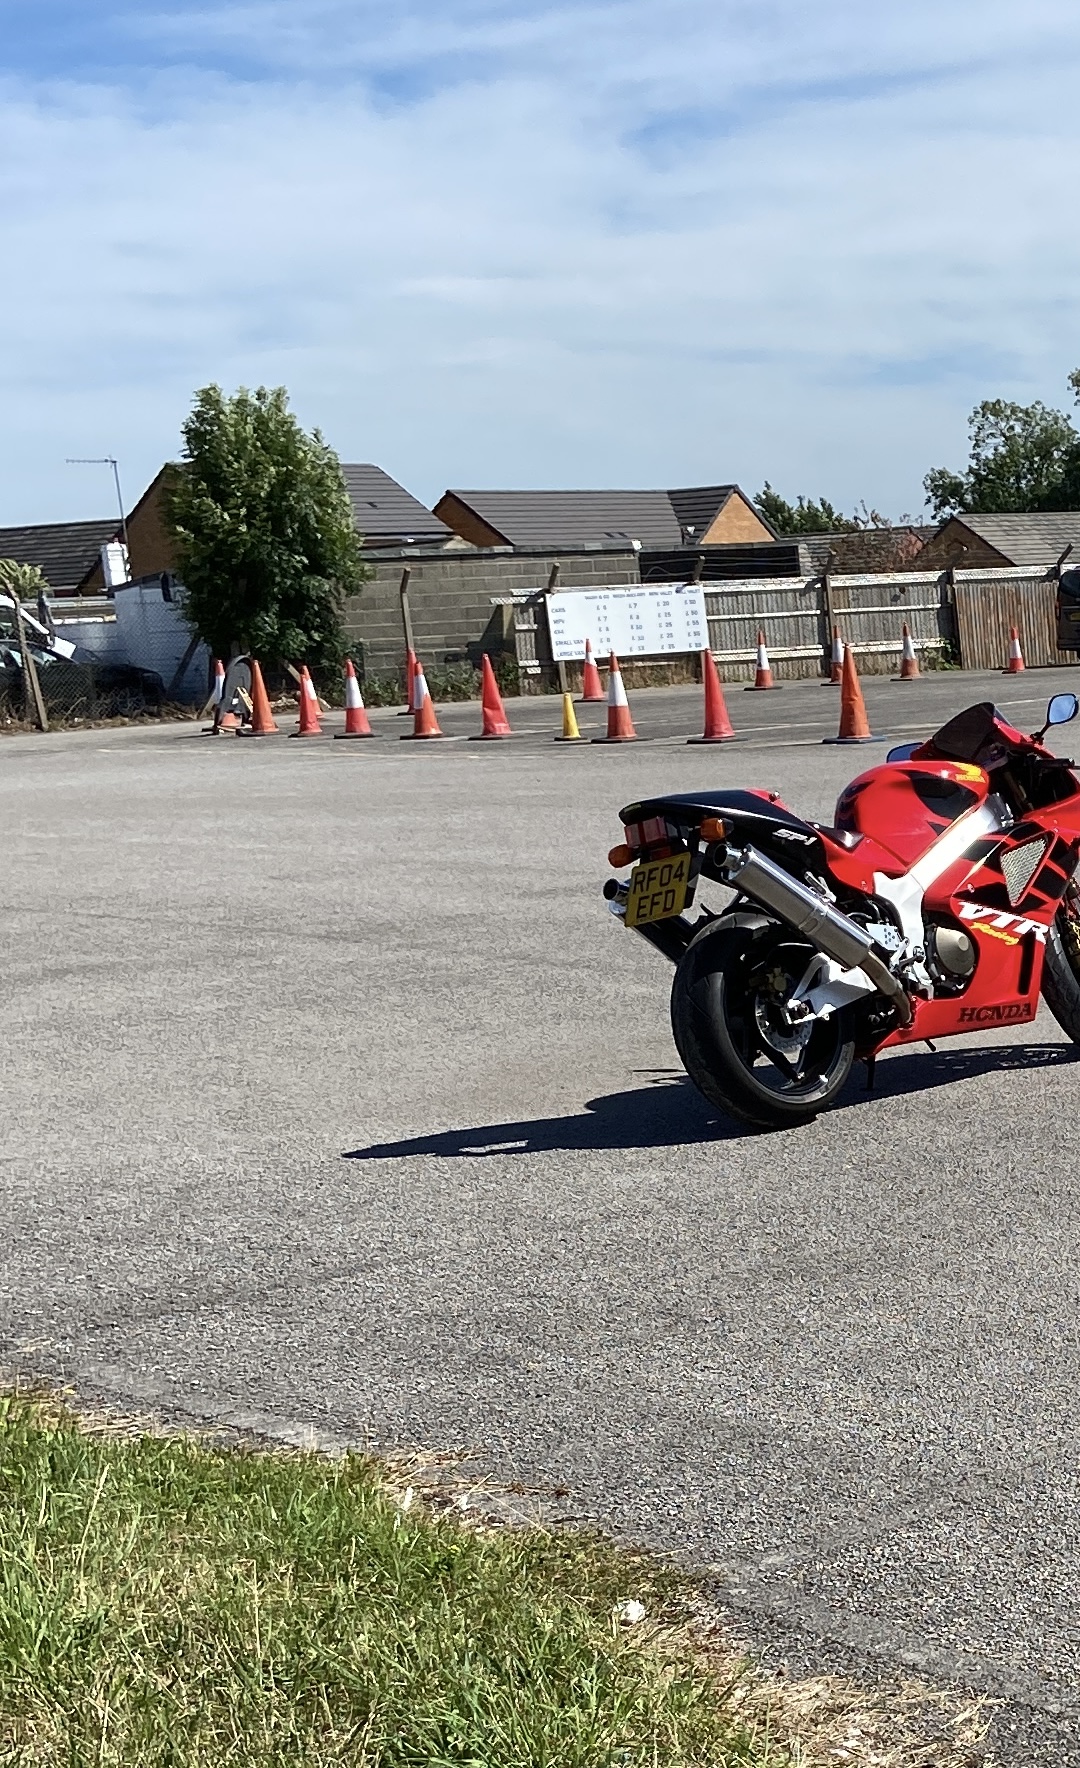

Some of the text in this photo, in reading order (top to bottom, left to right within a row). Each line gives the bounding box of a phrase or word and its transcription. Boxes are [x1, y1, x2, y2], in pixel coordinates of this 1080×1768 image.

[772, 829, 818, 845] SP-1
[633, 861, 685, 894] RF04
[637, 889, 676, 918] EFD
[957, 901, 1049, 945] VTR
[957, 1003, 1032, 1023] HONDA
